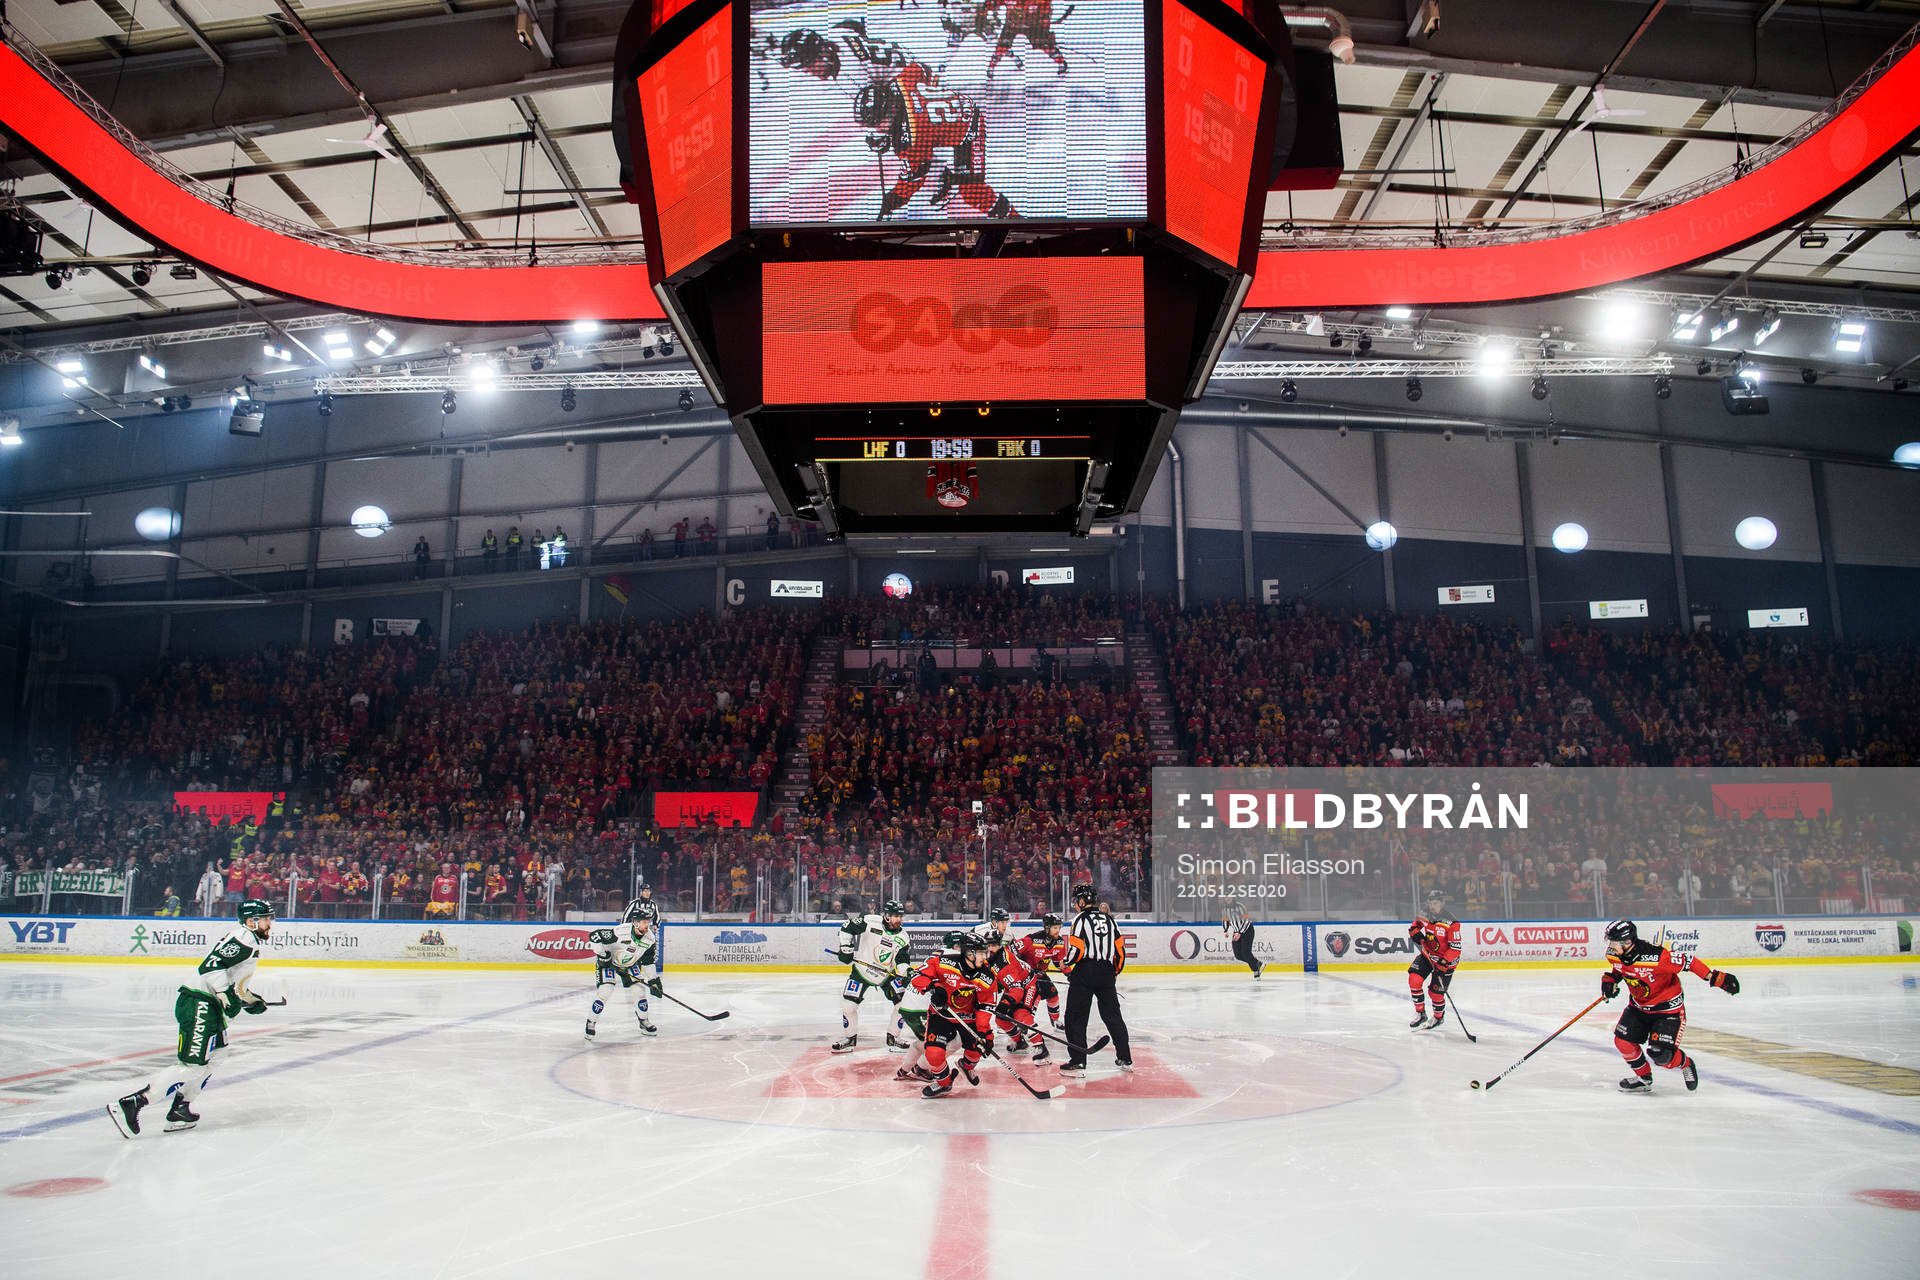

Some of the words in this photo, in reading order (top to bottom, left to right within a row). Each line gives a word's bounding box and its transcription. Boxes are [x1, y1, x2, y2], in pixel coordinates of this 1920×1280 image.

[1178, 34, 1193, 77] 0
[706, 45, 720, 86] 0
[1234, 73, 1248, 113] 0
[655, 85, 669, 125] 0
[1184, 103, 1233, 164] 19:59
[668, 113, 714, 175] 19:59
[130, 175, 205, 243] Lycka
[216, 229, 252, 262] till
[280, 253, 436, 304] slutspelet
[1360, 260, 1516, 293] wibergs
[863, 295, 1058, 344] SANT
[827, 362, 880, 377] Socialt
[885, 363, 936, 376] Ansvar
[949, 363, 990, 376] Norr
[995, 361, 1083, 375] Tillsammans
[863, 441, 889, 459] LHF
[896, 441, 906, 458] 0
[931, 439, 973, 458] 19:59
[997, 440, 1025, 456] FBK
[1030, 440, 1041, 456] 0
[727, 579, 745, 605] C
[1263, 579, 1280, 605] E
[1487, 590, 1492, 598] E
[1640, 603, 1645, 613] F
[334, 618, 354, 645] B
[8, 921, 77, 944] YBT
[1093, 919, 1108, 934] 25
[1475, 927, 1510, 945] ICA
[1518, 930, 1585, 941] KVANTUM
[1665, 929, 1700, 941] Svensk
[718, 945, 762, 954] PATOMELLA
[1671, 941, 1698, 952] Cater
[1759, 932, 1785, 948] 4Sign
[1505, 949, 1523, 957] ALLA
[1555, 946, 1587, 958] 7-23
[1641, 954, 1660, 962] SSAB
[940, 957, 956, 967] SSAB
[980, 972, 994, 985] SSAB
[1003, 974, 1014, 986] 20
[1648, 974, 1655, 983] C
[189, 1001, 209, 1057] KLARAVIK
